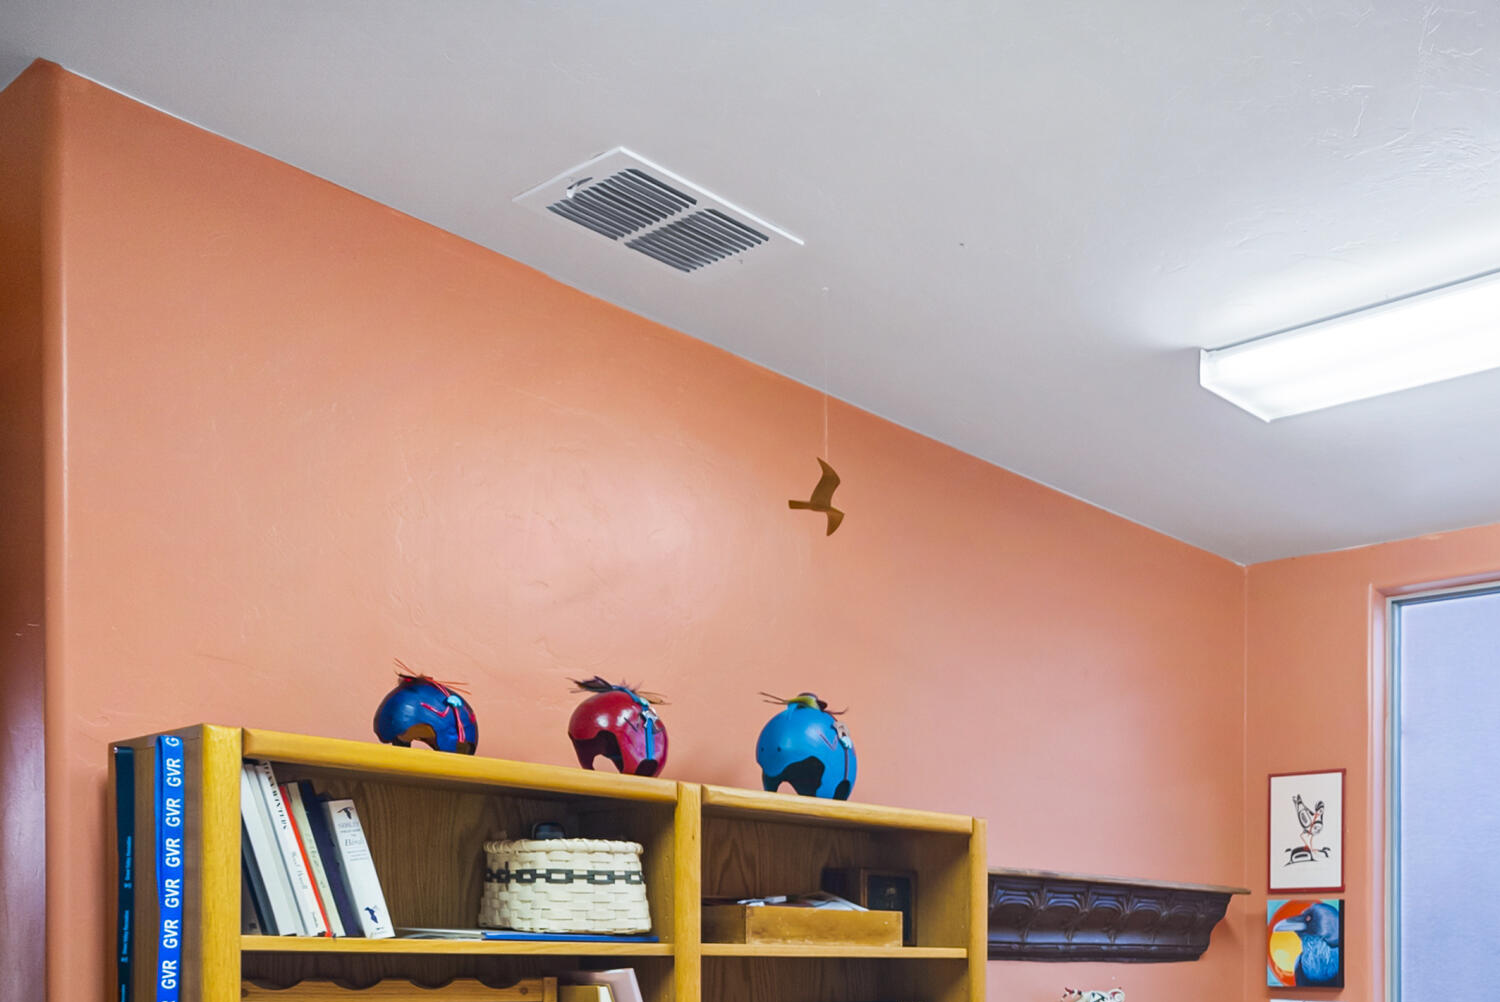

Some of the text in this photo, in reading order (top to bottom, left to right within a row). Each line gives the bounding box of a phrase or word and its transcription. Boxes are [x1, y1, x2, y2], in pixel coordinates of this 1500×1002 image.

[166, 757, 182, 787] GVR
[165, 797, 181, 827] GVR
[165, 837, 181, 867] GVR
[164, 878, 180, 908] GVR
[162, 918, 179, 949] GVR
[161, 959, 177, 990] GVR
